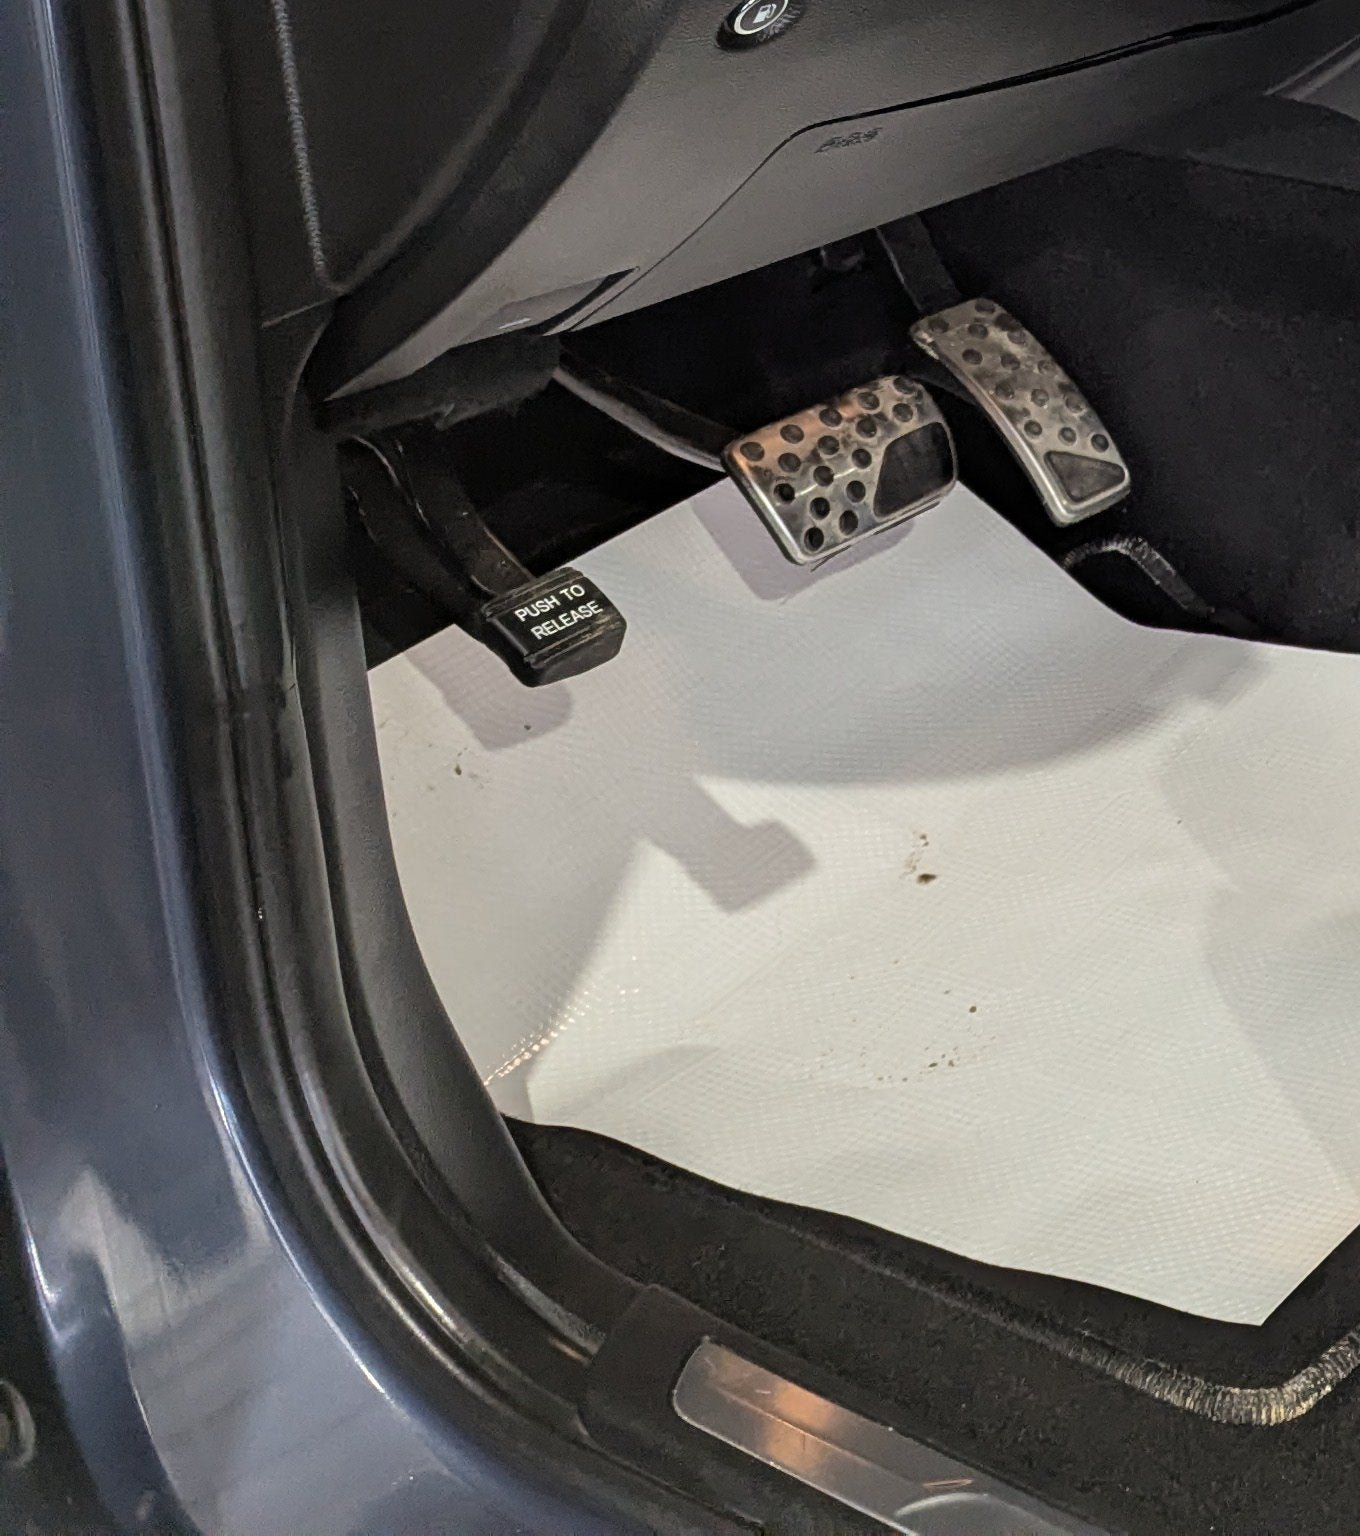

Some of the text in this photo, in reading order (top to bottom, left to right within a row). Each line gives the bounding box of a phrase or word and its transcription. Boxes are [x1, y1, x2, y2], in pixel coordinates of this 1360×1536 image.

[515, 584, 586, 622] PUSH TO
[531, 600, 604, 640] RELEASE
